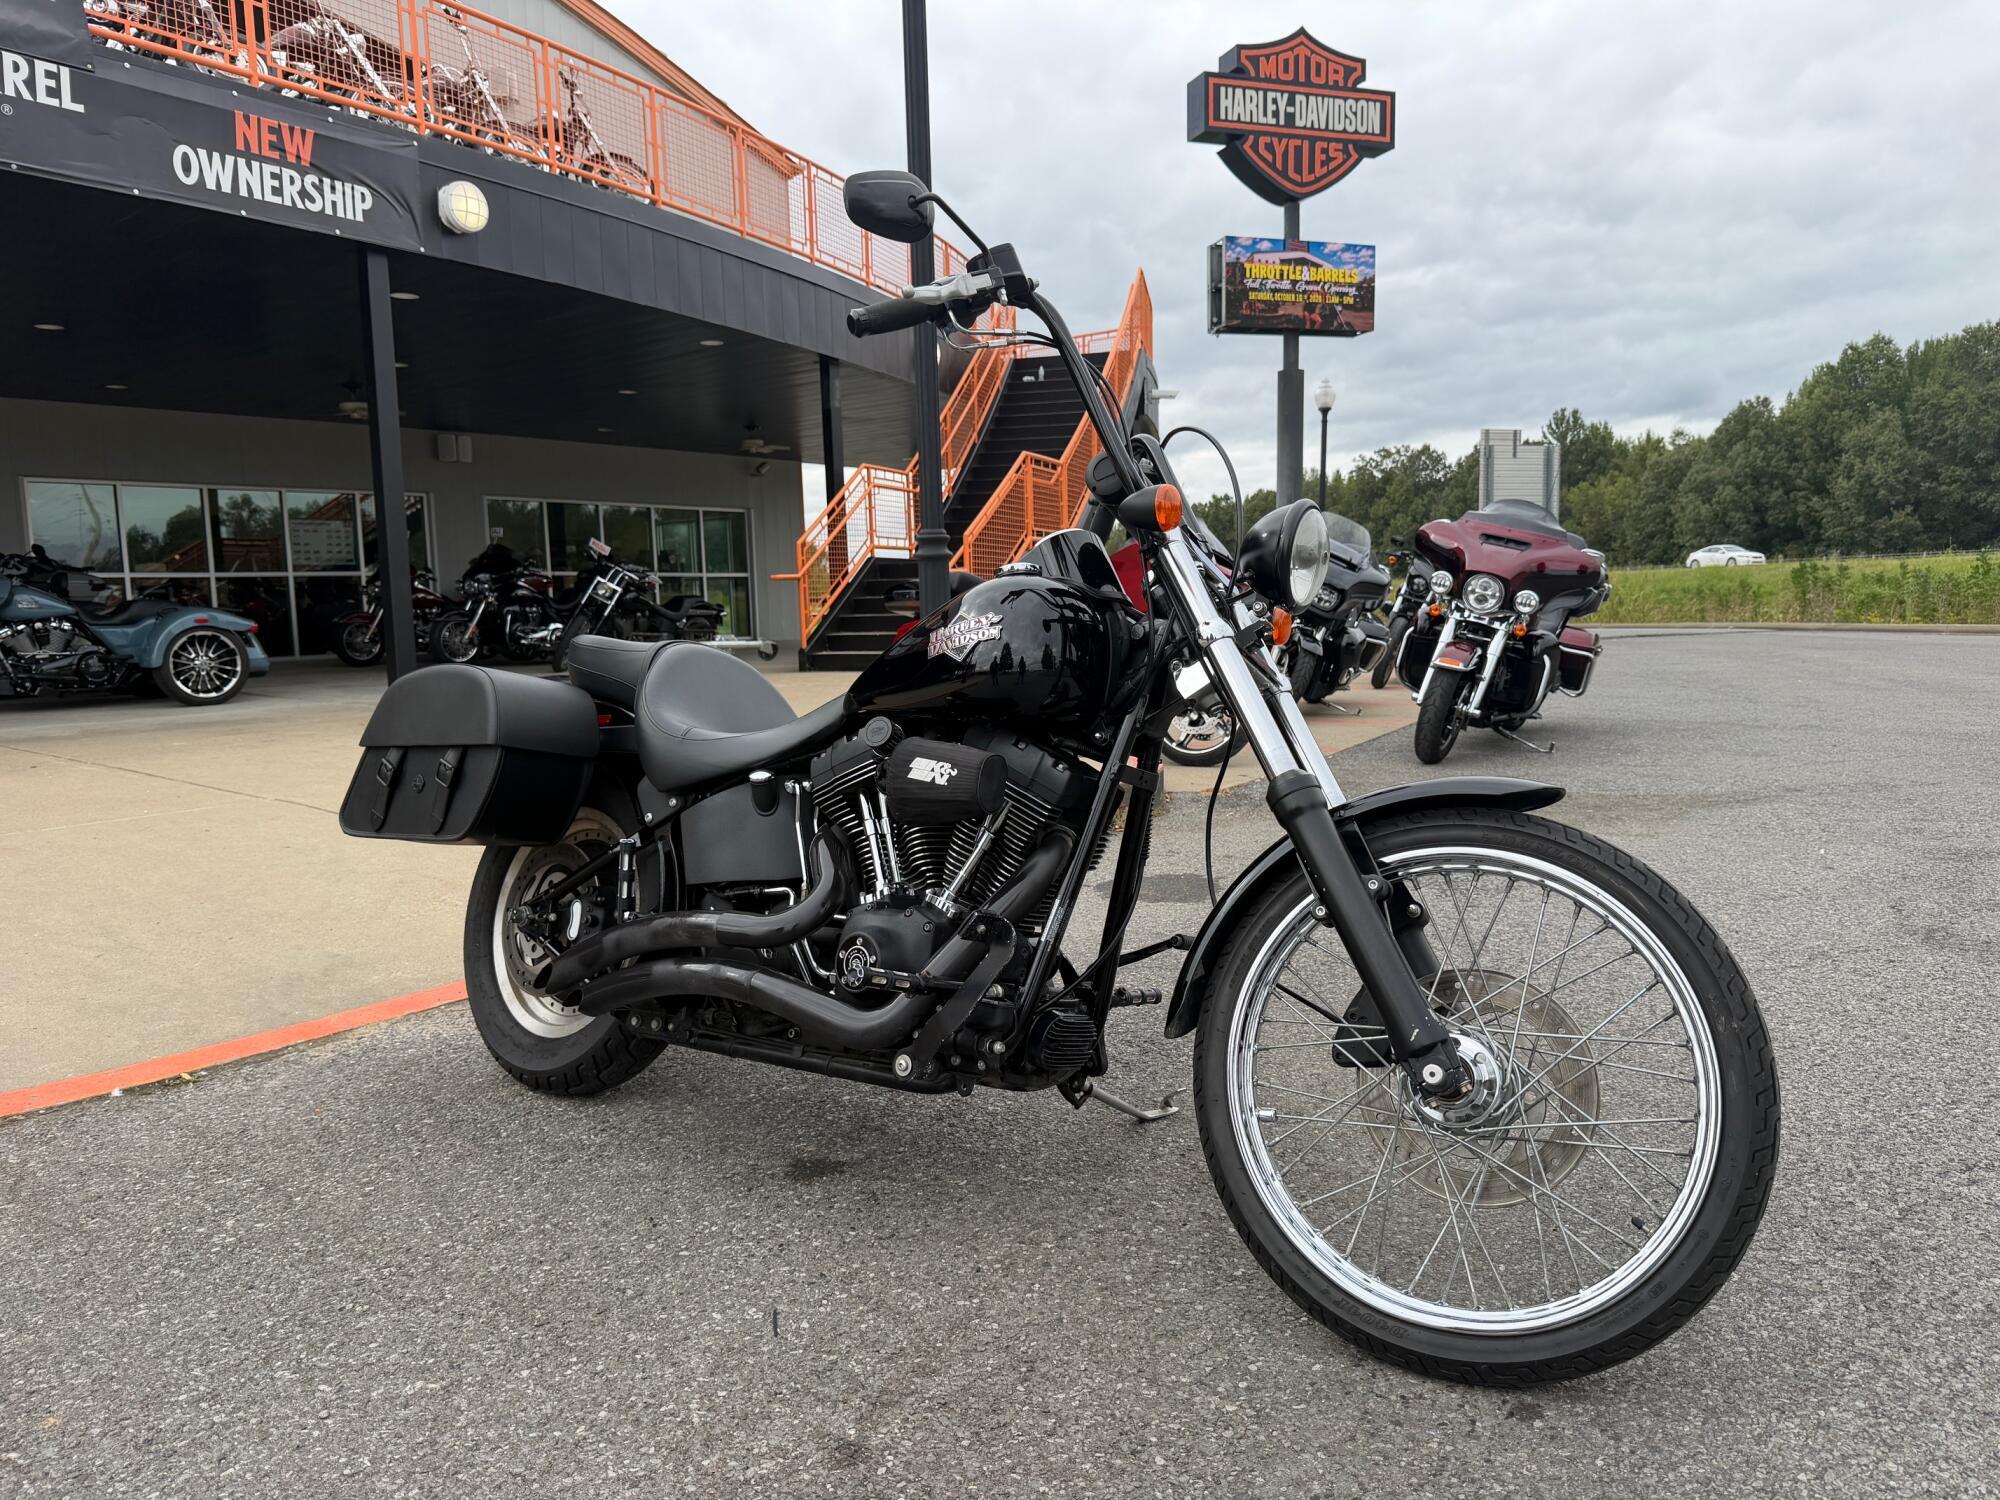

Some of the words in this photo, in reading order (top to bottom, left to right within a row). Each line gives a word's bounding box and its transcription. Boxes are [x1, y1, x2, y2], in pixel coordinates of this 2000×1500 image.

[0, 50, 85, 113] REL
[1259, 44, 1344, 87] MOTOR
[1219, 86, 1381, 135] HARLEY-DAVIDSON
[234, 110, 315, 167] NEW
[1258, 136, 1344, 183] CYCLES
[173, 144, 373, 222] OWNERSHIP
[1244, 262, 1302, 281] THROTTLE
[1309, 266, 1359, 284] BARRELS
[1295, 281, 1323, 293] Grand
[1324, 282, 1358, 296] Opening
[927, 625, 1003, 660] DAVIDSON
